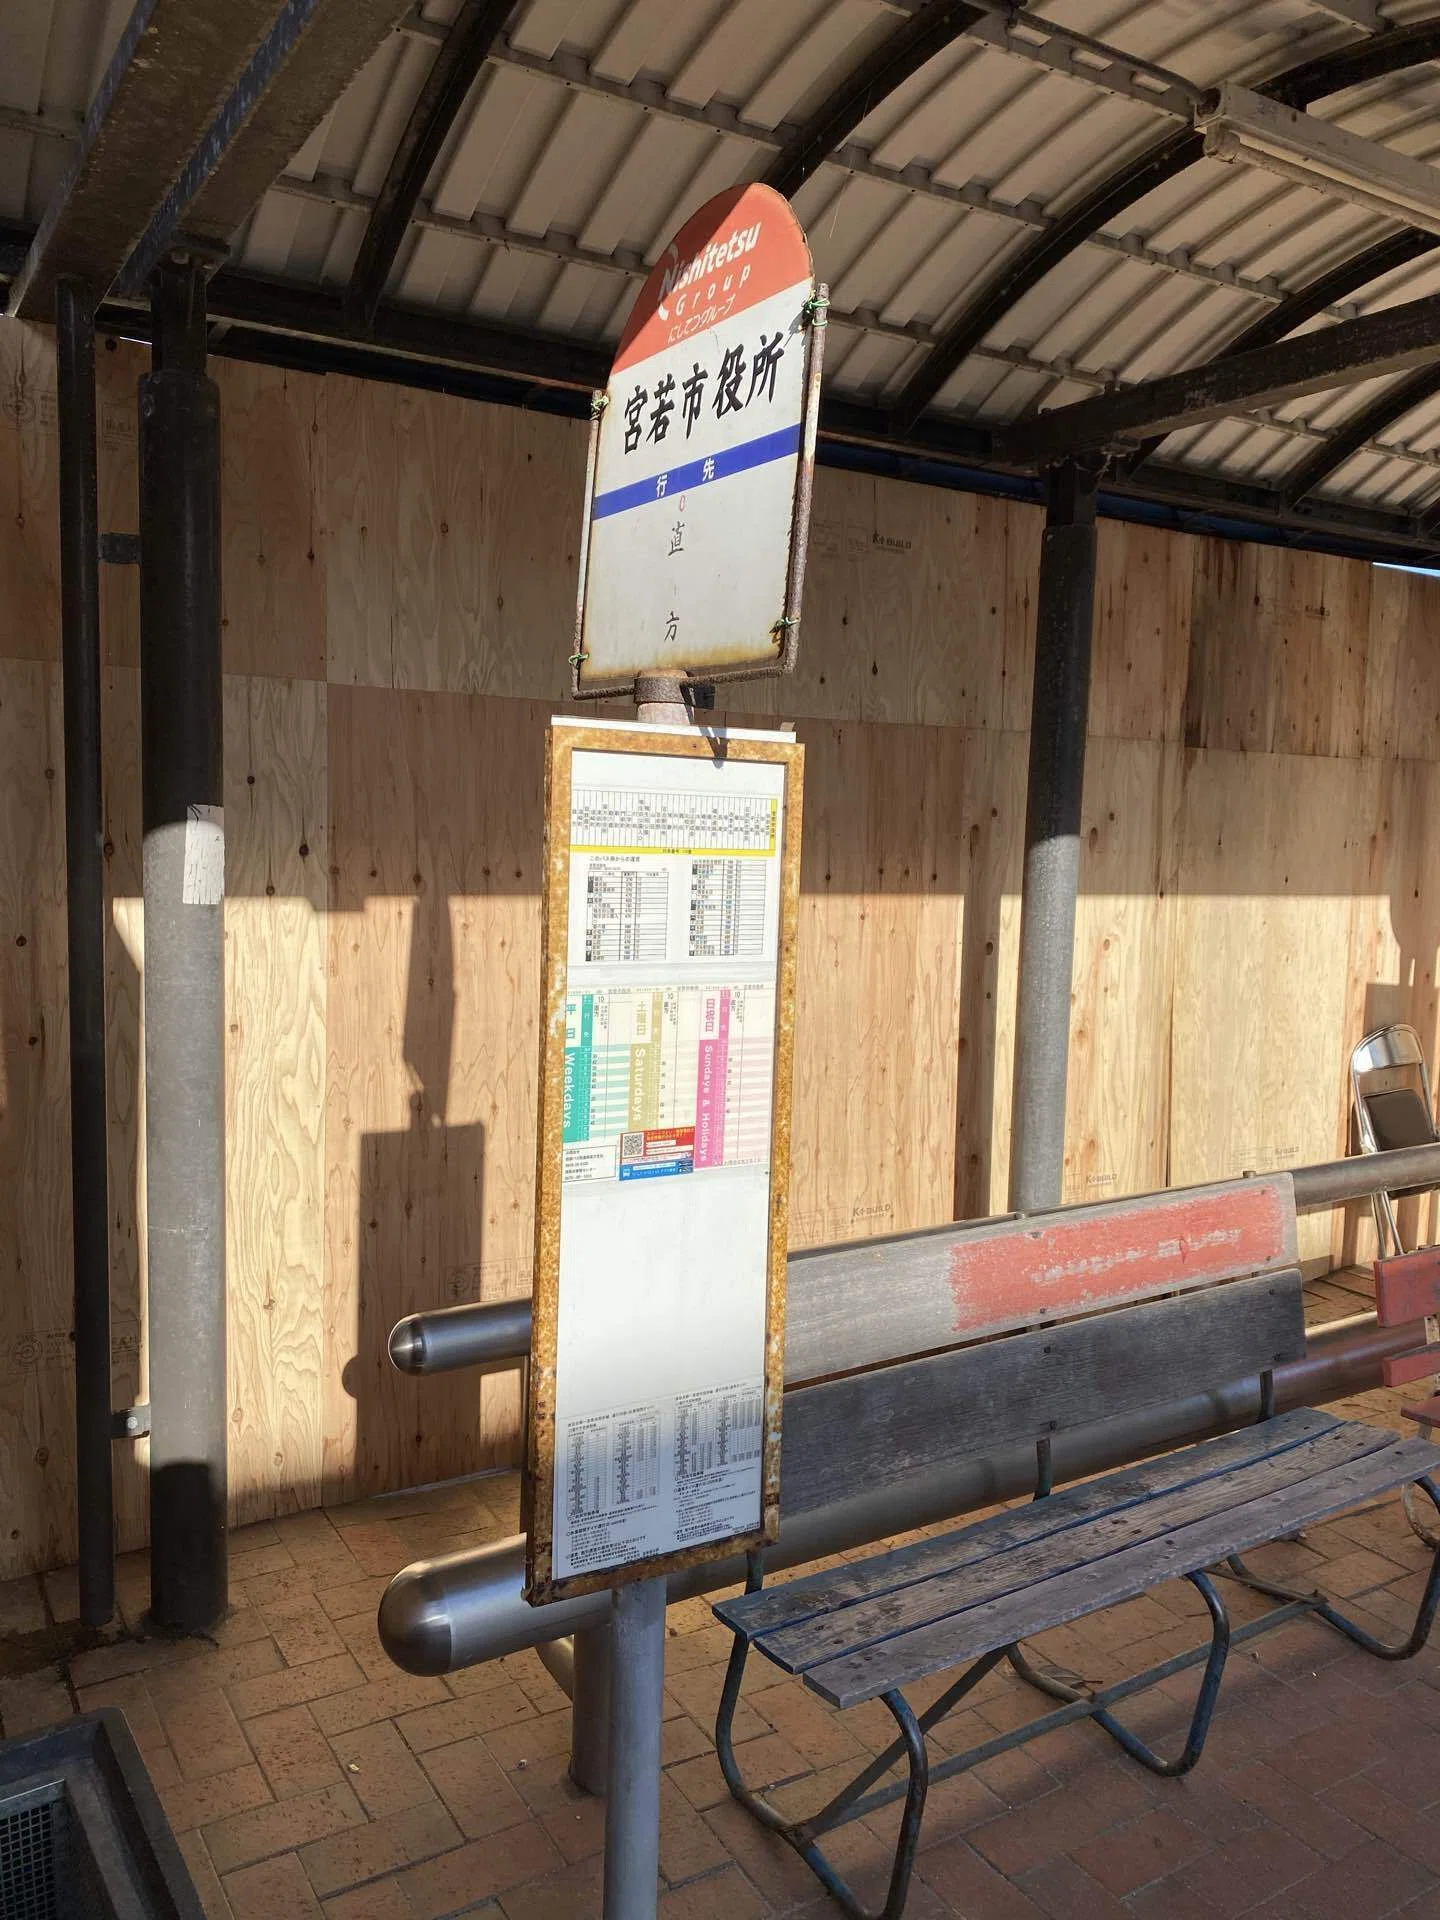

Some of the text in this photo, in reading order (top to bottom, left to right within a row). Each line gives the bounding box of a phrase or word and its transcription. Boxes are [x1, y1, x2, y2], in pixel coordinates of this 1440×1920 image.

[657, 222, 762, 316] Nishitetsu
[675, 264, 752, 316] Group
[667, 292, 737, 344] にしてつグループ
[624, 331, 785, 455] 宮若市役所
[563, 1052, 576, 1128] Weekdays
